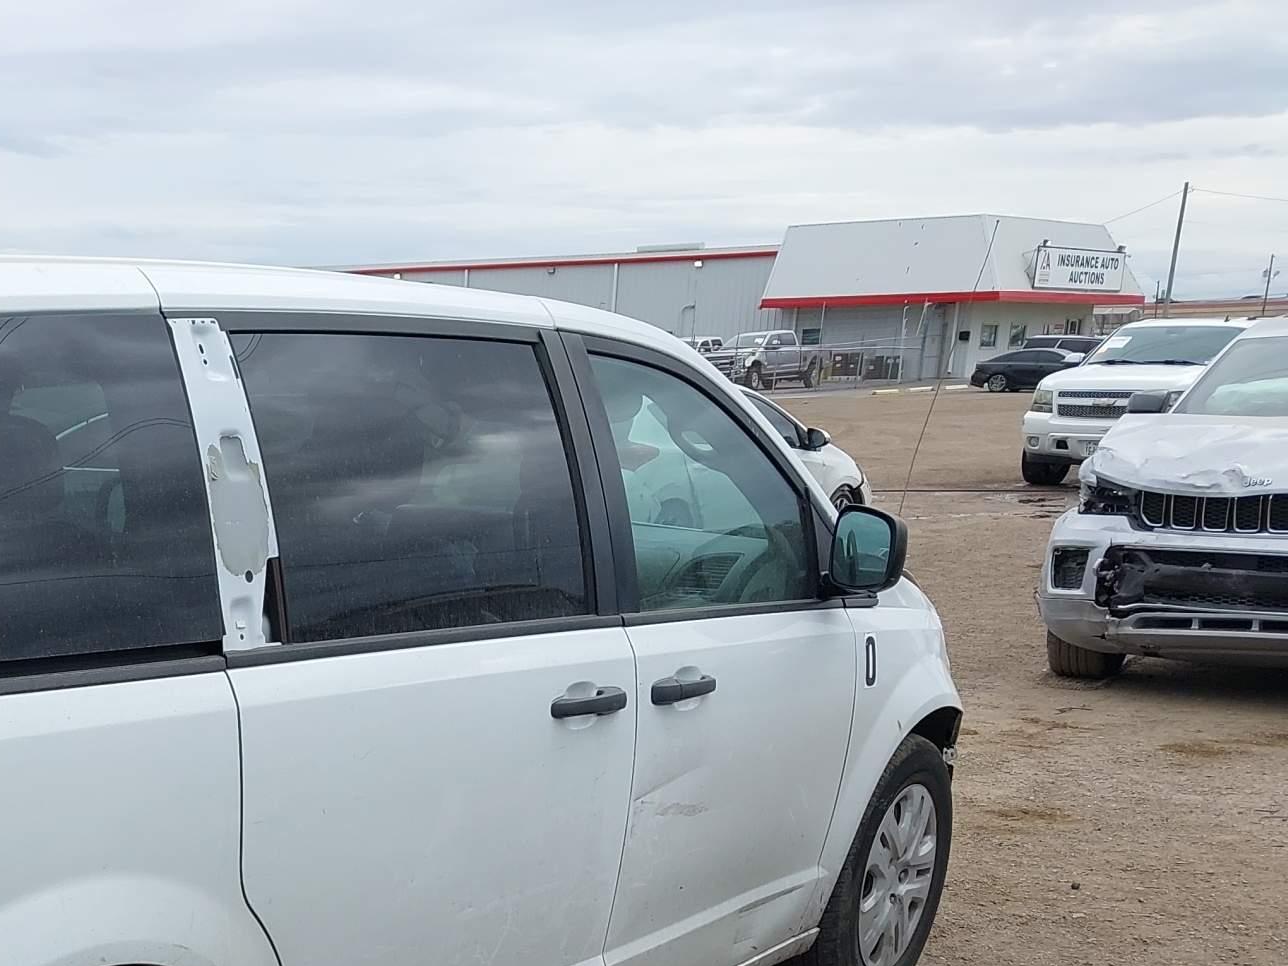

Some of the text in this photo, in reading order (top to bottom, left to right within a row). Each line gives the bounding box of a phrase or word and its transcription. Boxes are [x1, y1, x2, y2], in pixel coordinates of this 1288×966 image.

[1057, 254, 1099, 269] INSURANCE
[1100, 256, 1120, 270] AUTO
[1069, 271, 1105, 285] AUCTIONS
[1242, 476, 1272, 488] Jeep
